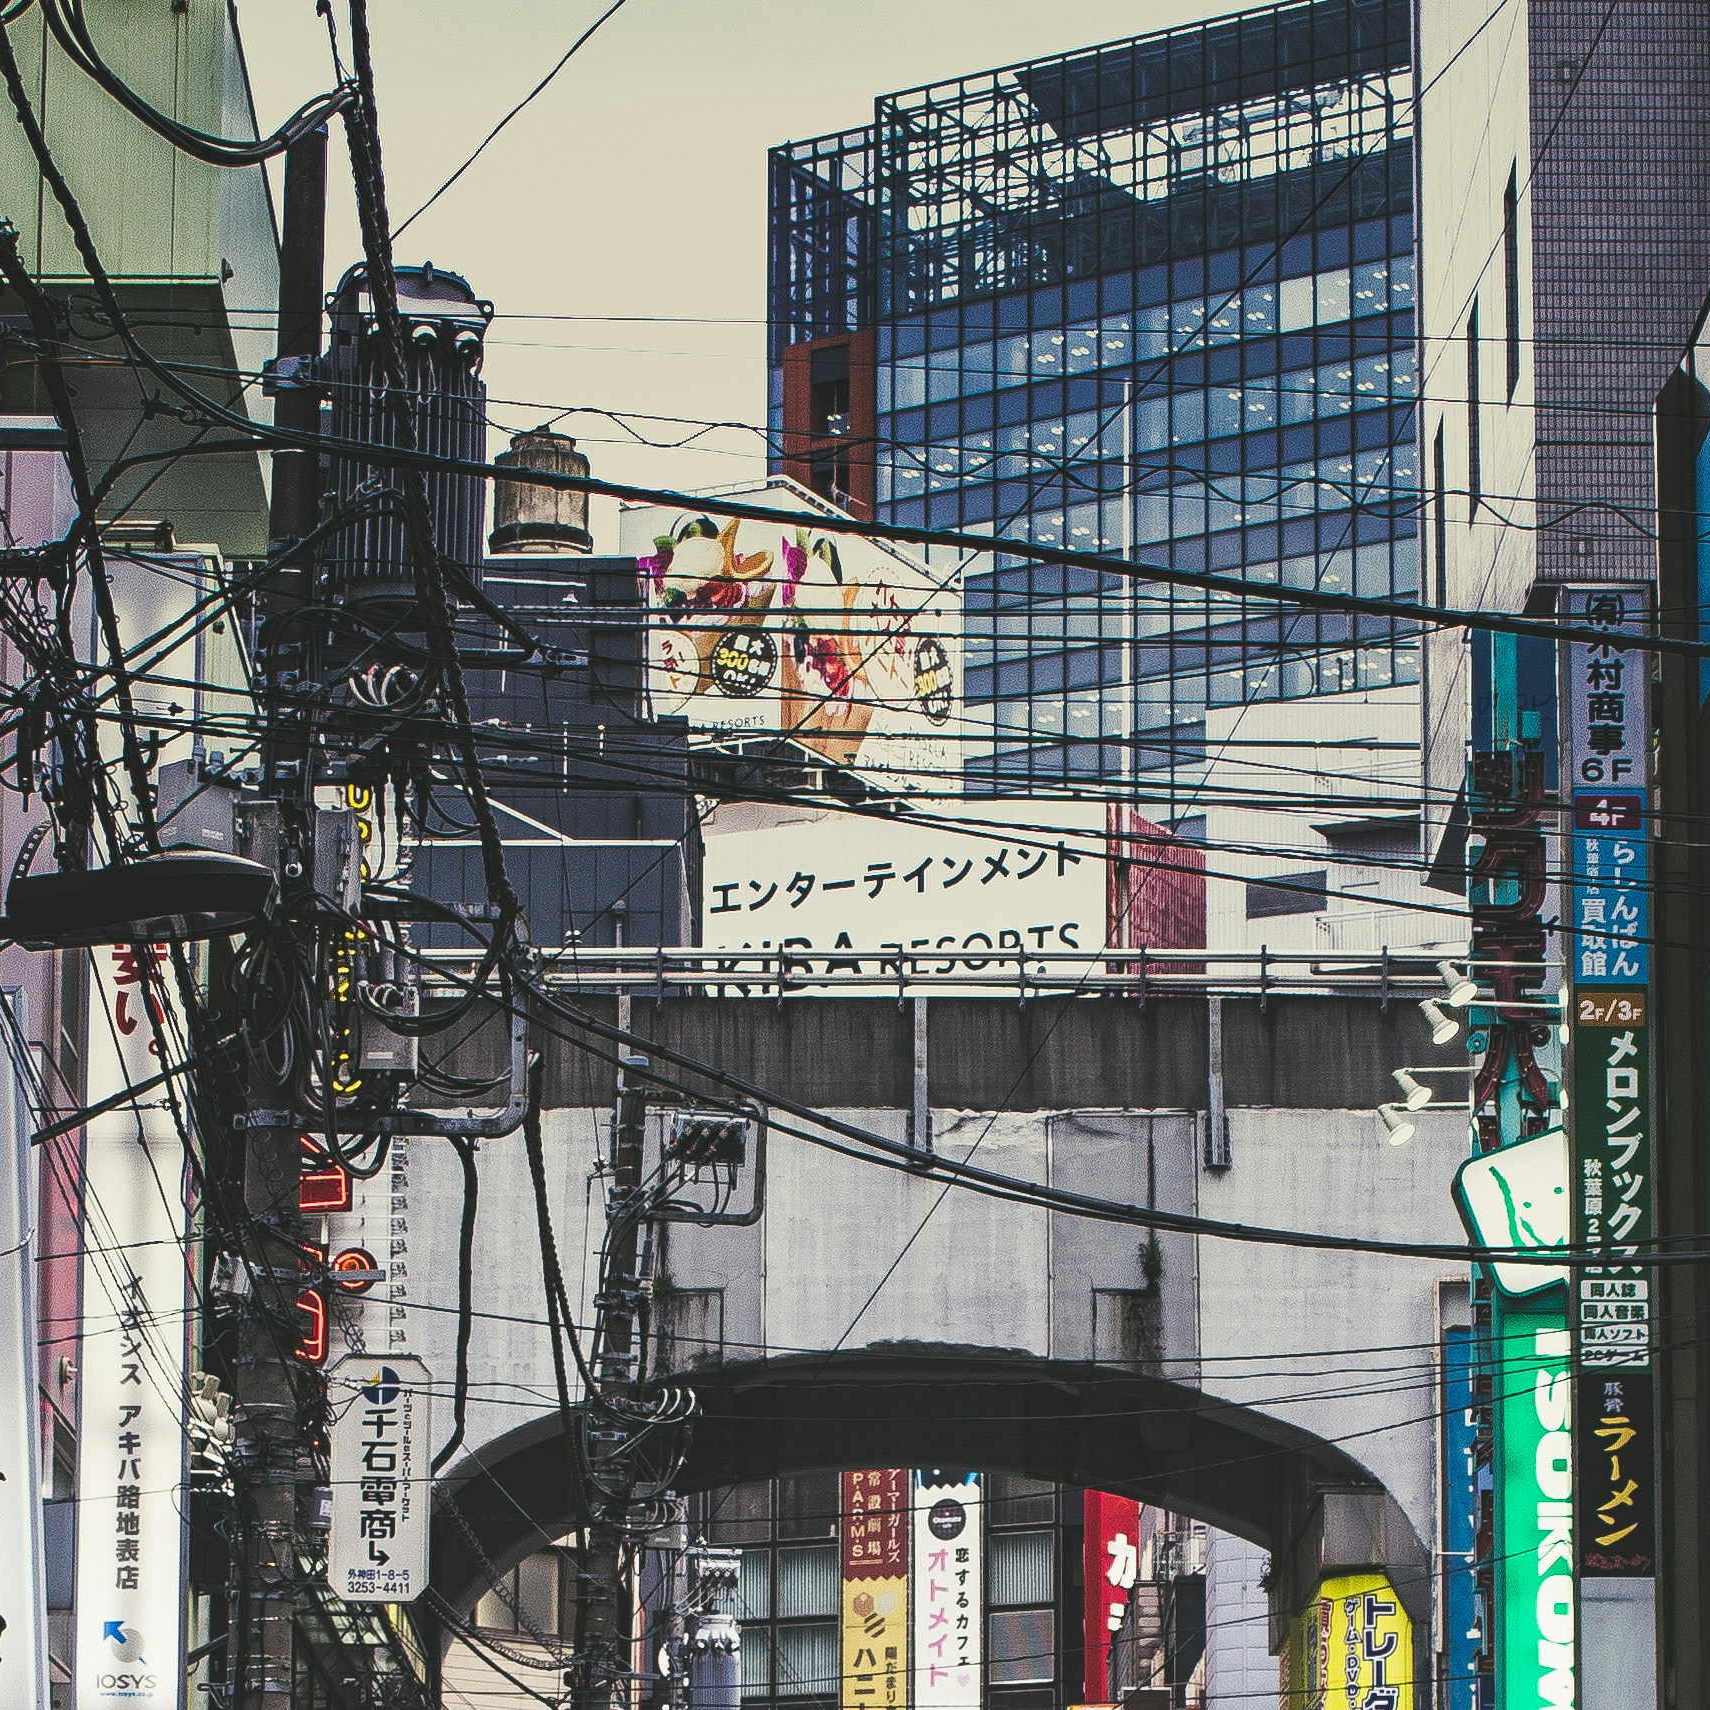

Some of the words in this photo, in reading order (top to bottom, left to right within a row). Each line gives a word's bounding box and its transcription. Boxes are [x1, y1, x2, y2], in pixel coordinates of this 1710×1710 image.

[1581, 757, 1632, 782] 6F
[1589, 797, 1626, 829] 4F
[709, 838, 1083, 915] エンターテインメント
[1470, 748, 1552, 1155] ツクモパ
[1579, 1000, 1643, 1026] 2F/3F
[1589, 1281, 1637, 1298] 同人誌
[113, 1403, 145, 1591] アキバ路地表店
[360, 1408, 399, 1540] 千石電商
[1593, 1416, 1639, 1548] ラーメン
[347, 1568, 411, 1582] 外神田1-8-5
[347, 1581, 411, 1595] 3253-4411
[927, 1548, 951, 1689] オトメイト
[954, 1547, 970, 1667] 恋するカフェ
[95, 1672, 158, 1691] IOSYS
